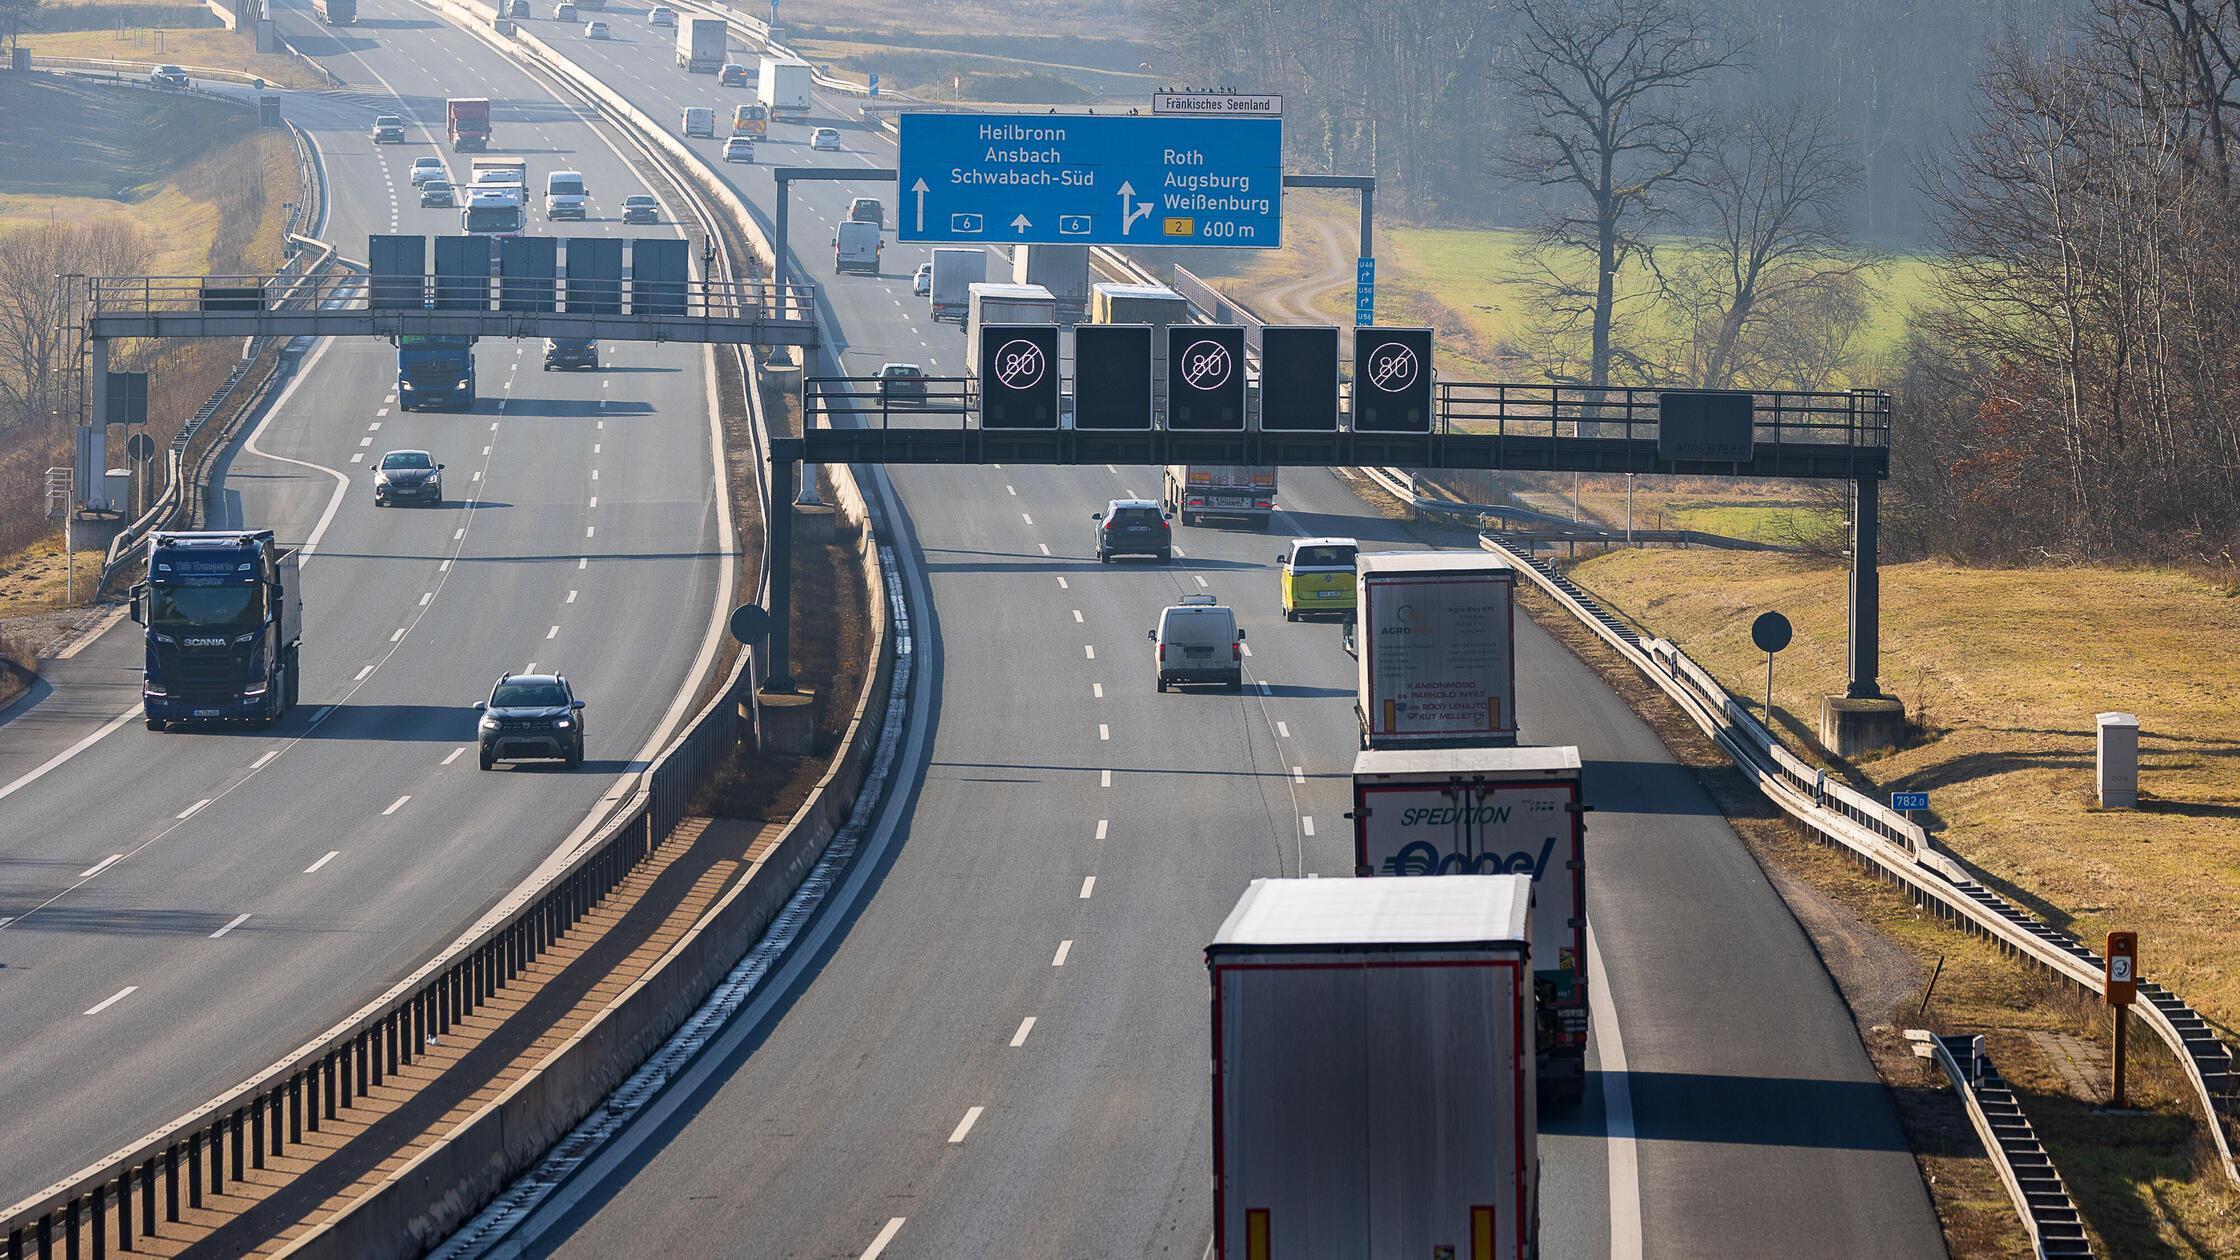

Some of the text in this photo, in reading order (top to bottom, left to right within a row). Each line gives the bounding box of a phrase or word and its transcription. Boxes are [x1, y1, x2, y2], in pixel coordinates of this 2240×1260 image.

[1166, 97, 1270, 112] Fränkisches Seenland
[979, 125, 1066, 141] Heilbronn
[984, 146, 1061, 163] Ansbach
[1164, 149, 1204, 166] Roth
[951, 167, 1094, 187] Schwabach-Süd
[1163, 172, 1250, 193] Augsburg
[1163, 194, 1270, 215] Weißenburg
[963, 217, 972, 231] 6
[1071, 218, 1080, 232] 6
[1175, 221, 1183, 234] 2
[1203, 221, 1255, 238] 600 m
[1006, 353, 1035, 375] 80
[1192, 353, 1221, 376] 80
[1379, 355, 1408, 378] 80
[183, 638, 226, 647] SCANIA
[1400, 806, 1512, 827] SPEDITION
